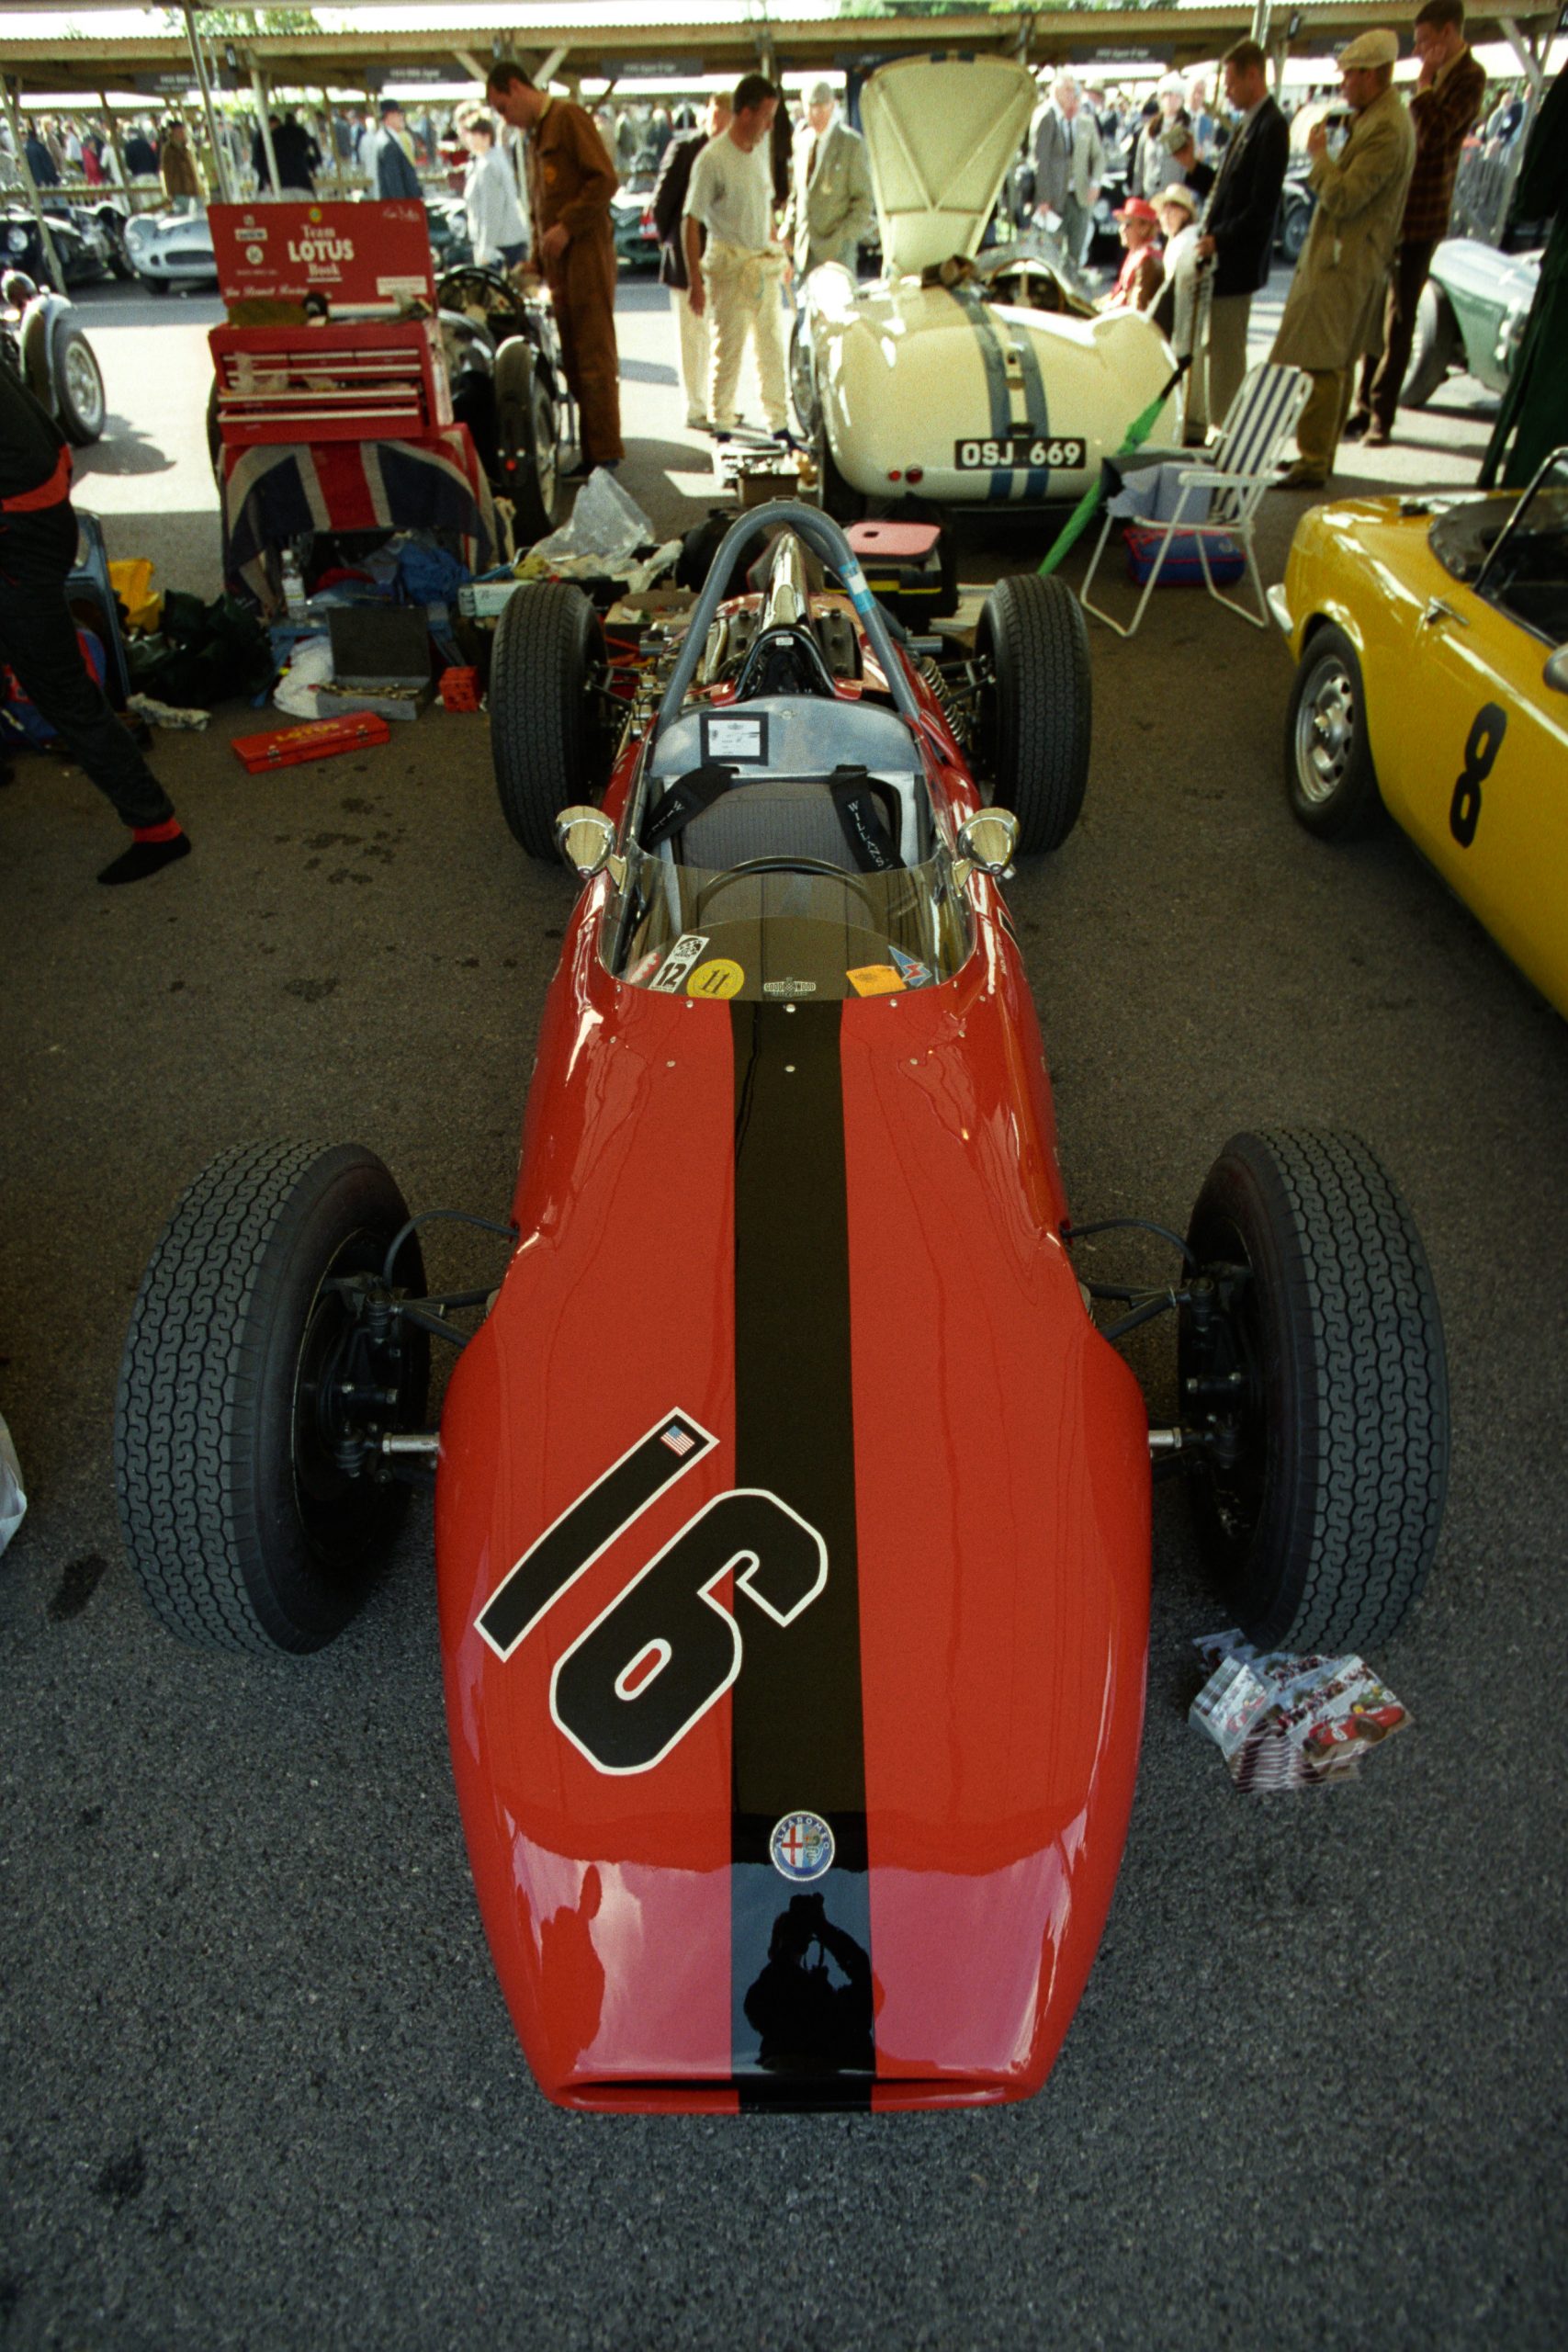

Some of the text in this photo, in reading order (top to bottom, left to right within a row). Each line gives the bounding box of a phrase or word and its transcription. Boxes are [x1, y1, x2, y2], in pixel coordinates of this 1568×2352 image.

[288, 239, 355, 263] LOTUS
[961, 441, 1081, 468] OSJ 669
[1449, 701, 1507, 850] 8
[847, 799, 885, 868] WILLANS
[655, 961, 687, 988] 12
[701, 969, 730, 994] 11
[473, 1406, 828, 1777] 16
